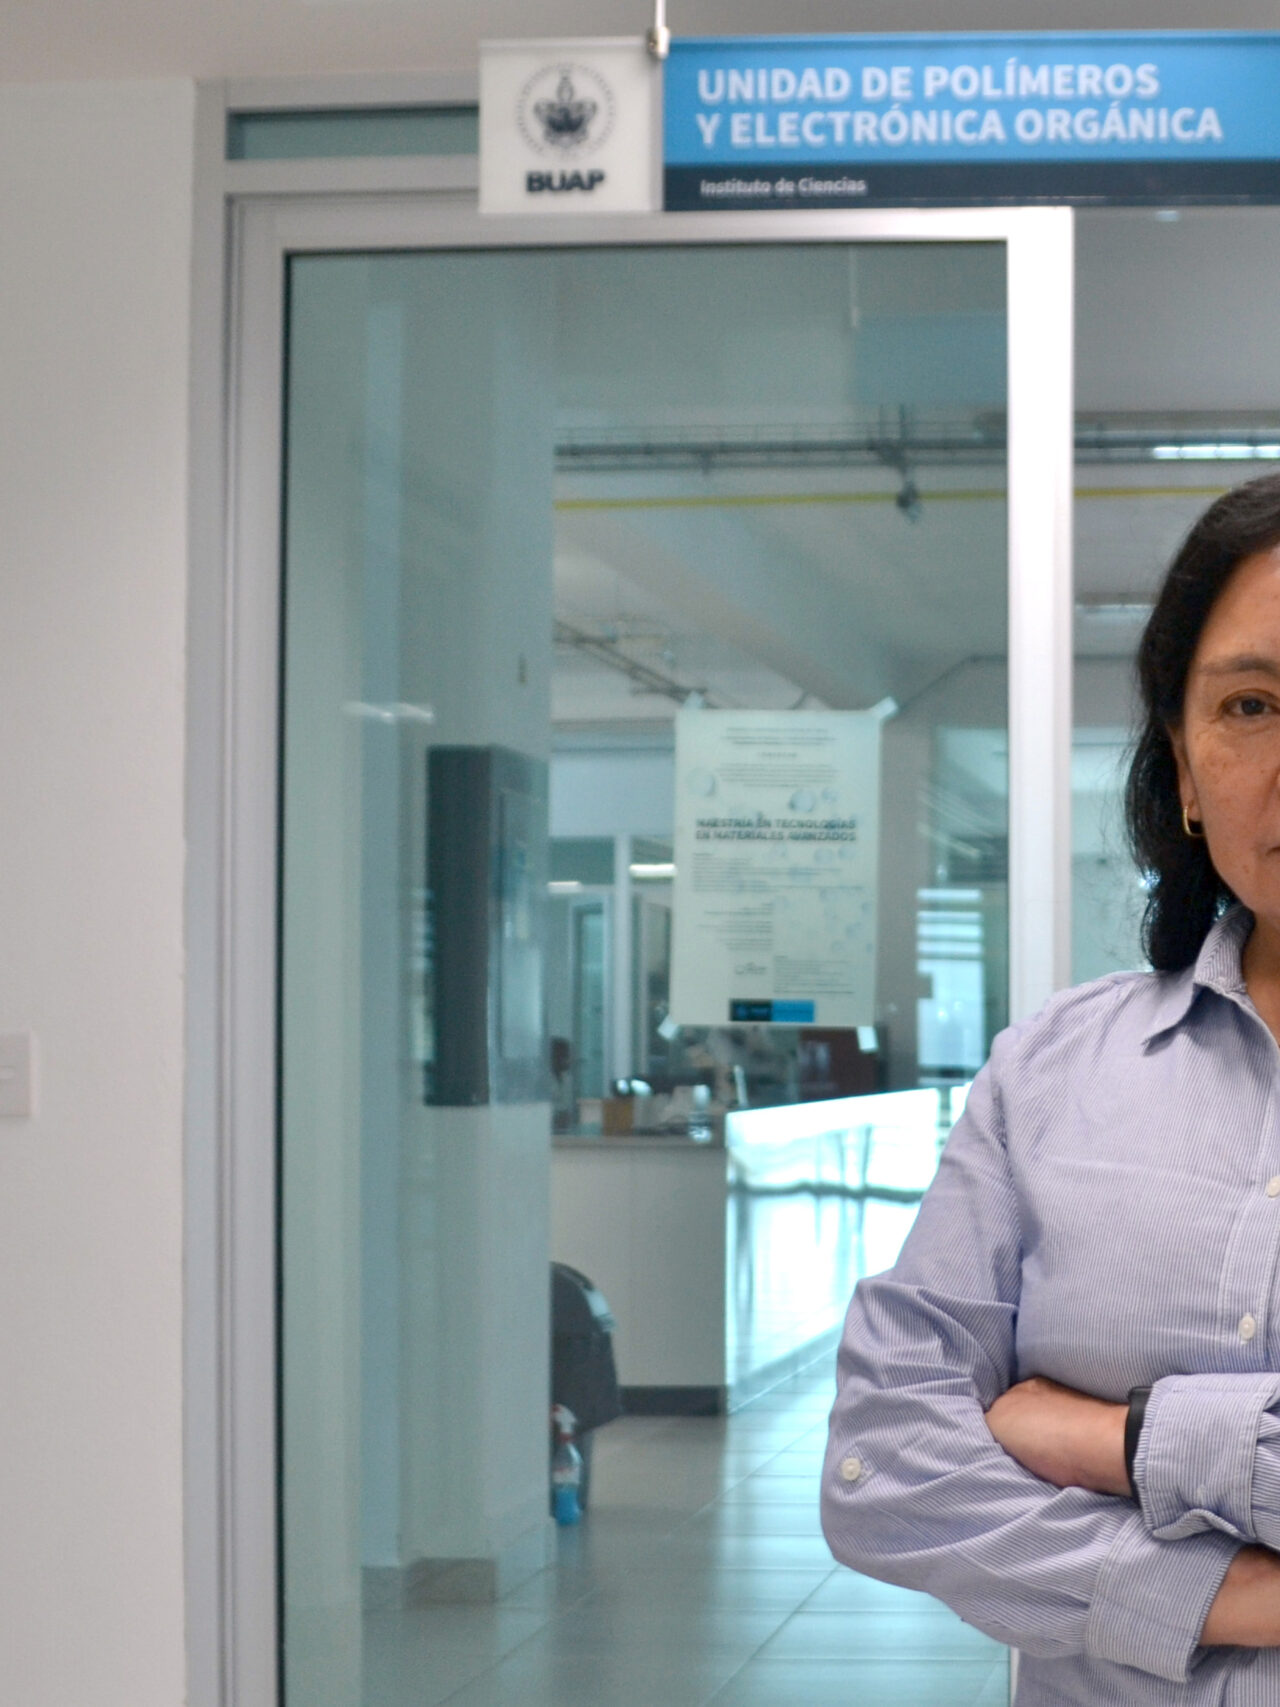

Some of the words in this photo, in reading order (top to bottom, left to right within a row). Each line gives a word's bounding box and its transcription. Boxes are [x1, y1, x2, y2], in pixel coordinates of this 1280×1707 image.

[698, 67, 851, 102] UNIDAD
[861, 65, 914, 99] DE
[923, 57, 1160, 98] POLÍMEROS
[696, 112, 722, 145] Y
[730, 103, 1006, 146] ELECTRÓNICA
[1014, 101, 1223, 142] ORGÁNICA
[526, 168, 606, 192] BUAP
[700, 178, 771, 195] Instituto
[774, 176, 795, 193] de
[798, 175, 868, 193] Ciencias
[695, 829, 710, 841] EN
[713, 829, 784, 841] MATERIALES
